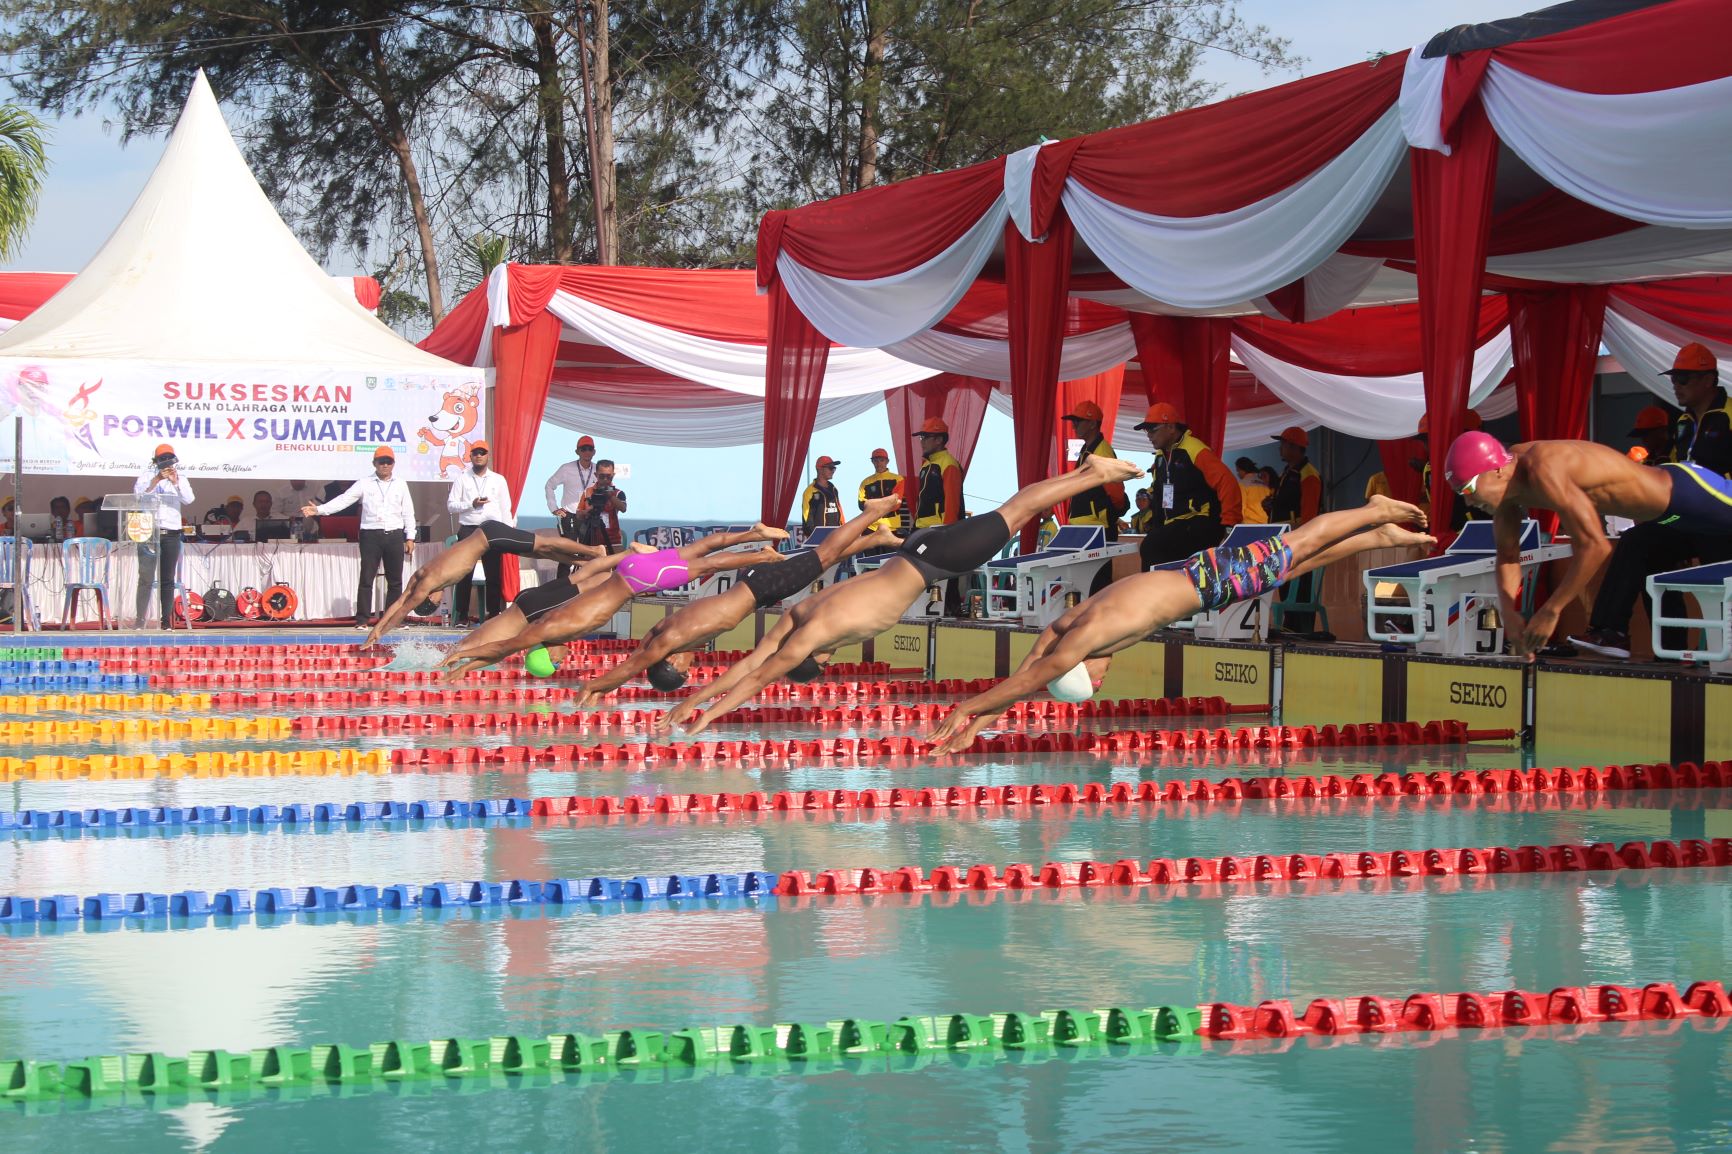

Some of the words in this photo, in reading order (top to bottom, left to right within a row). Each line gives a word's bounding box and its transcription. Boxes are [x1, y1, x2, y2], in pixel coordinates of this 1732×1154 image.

[163, 381, 352, 403] SUKSESKAN
[167, 401, 211, 411] PEKAN
[216, 403, 287, 412] OLAHRAGA
[291, 404, 348, 414] WILAYAH
[103, 414, 218, 439] PORWIL
[225, 417, 246, 440] X
[252, 417, 407, 442] SUMATERA
[274, 443, 335, 452] BENGKULU
[1519, 553, 1534, 562] anti
[1025, 576, 1035, 612] 3
[1239, 598, 1261, 630] 4
[1476, 608, 1497, 653] 5
[893, 634, 921, 653] SEIKO
[1215, 661, 1258, 685] SEIKO
[1449, 681, 1507, 709] SEIKO
